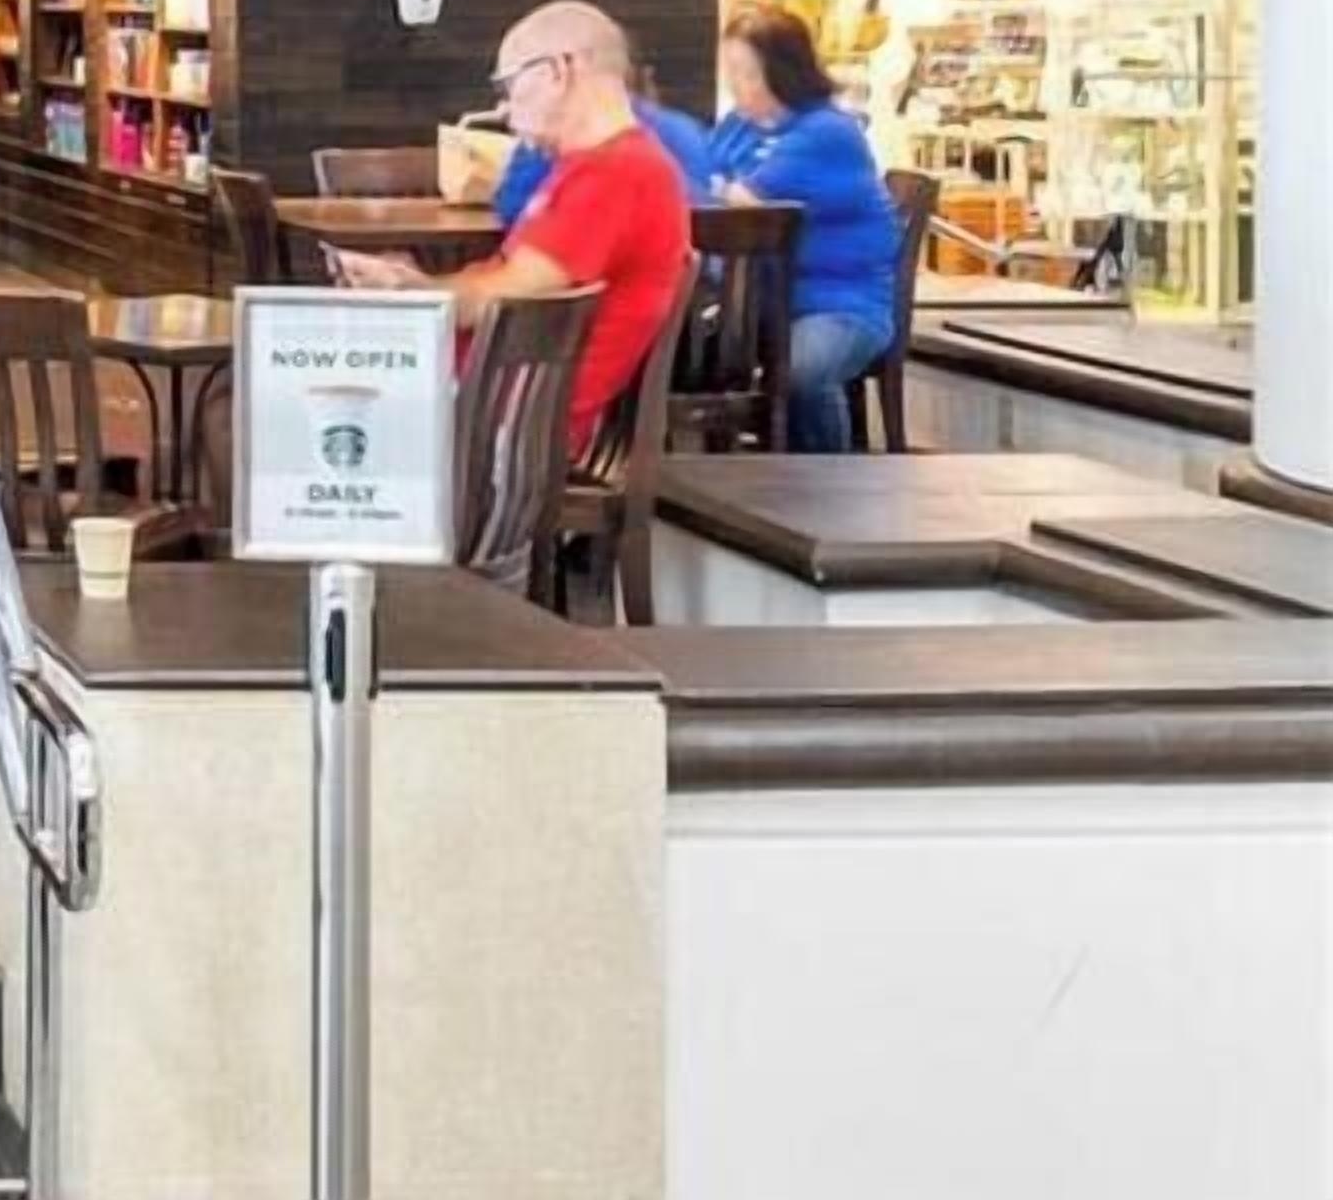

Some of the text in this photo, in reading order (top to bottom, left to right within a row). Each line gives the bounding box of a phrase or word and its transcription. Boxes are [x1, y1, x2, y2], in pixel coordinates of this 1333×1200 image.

[271, 350, 417, 368] NOW OPEN
[308, 484, 376, 503] DAILY
